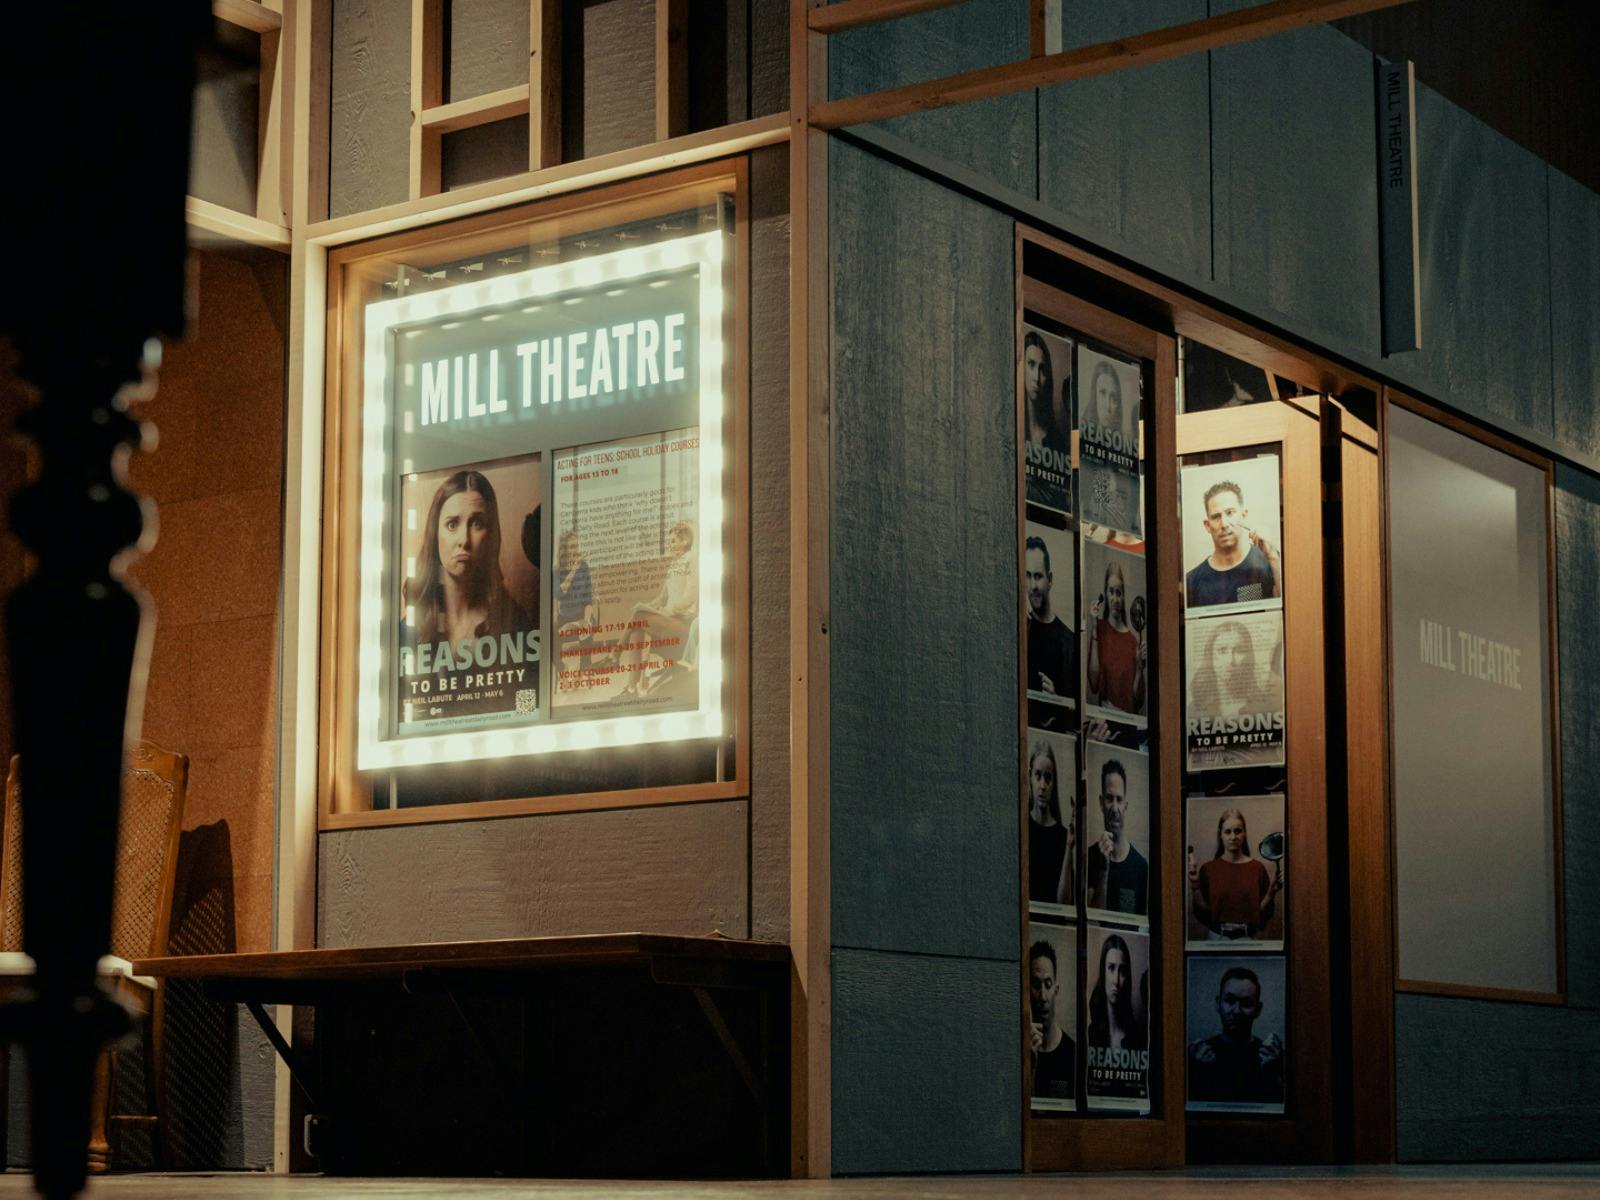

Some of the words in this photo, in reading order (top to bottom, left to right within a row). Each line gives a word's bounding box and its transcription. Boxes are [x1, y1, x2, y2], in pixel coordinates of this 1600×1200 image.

[1387, 71, 1401, 110] MILL
[1388, 114, 1404, 189] THEATRE
[421, 349, 508, 426] MILL
[516, 313, 685, 408] THEATRE
[1080, 420, 1139, 457] REASONS
[557, 457, 578, 470] ACTING
[579, 455, 592, 467] FOR
[616, 448, 641, 461] SCHOOL
[642, 443, 670, 457] HOLIDAY
[671, 437, 699, 452] COURSES
[1025, 440, 1072, 475] ASONS
[1085, 444, 1095, 454] TO
[1097, 449, 1106, 459] BE
[1108, 451, 1134, 468] PRETTY
[561, 474, 573, 483] FOR
[574, 472, 591, 481] AGES
[600, 469, 610, 477] TO
[1037, 469, 1065, 485] PRETTY
[559, 626, 603, 638] ACTIONING
[627, 619, 650, 630] APRIL
[559, 646, 612, 658] SHAKESPEARE
[636, 637, 681, 650] SEPTEMBER
[1418, 617, 1457, 672] MILL
[1458, 630, 1522, 690] THEATRE
[410, 680, 431, 694] TO
[439, 676, 458, 691] BE
[465, 668, 525, 688] PRETTY
[559, 669, 581, 680] VOICE
[582, 666, 615, 678] COURSE
[638, 661, 660, 671] APRIL
[662, 659, 673, 668] OR
[574, 677, 610, 689] OCTOBER
[428, 693, 453, 704] LABUTE
[456, 692, 473, 702] APRIL
[485, 690, 498, 698] MAY
[1188, 711, 1284, 737] REASONS
[1196, 738, 1211, 746] TO
[1215, 736, 1228, 745] BE
[1233, 732, 1273, 744] PRETTY
[1088, 1046, 1149, 1070] REASONS
[1093, 1069, 1102, 1079] TO
[1104, 1070, 1114, 1080] BE
[1116, 1071, 1141, 1081] PRETTY
